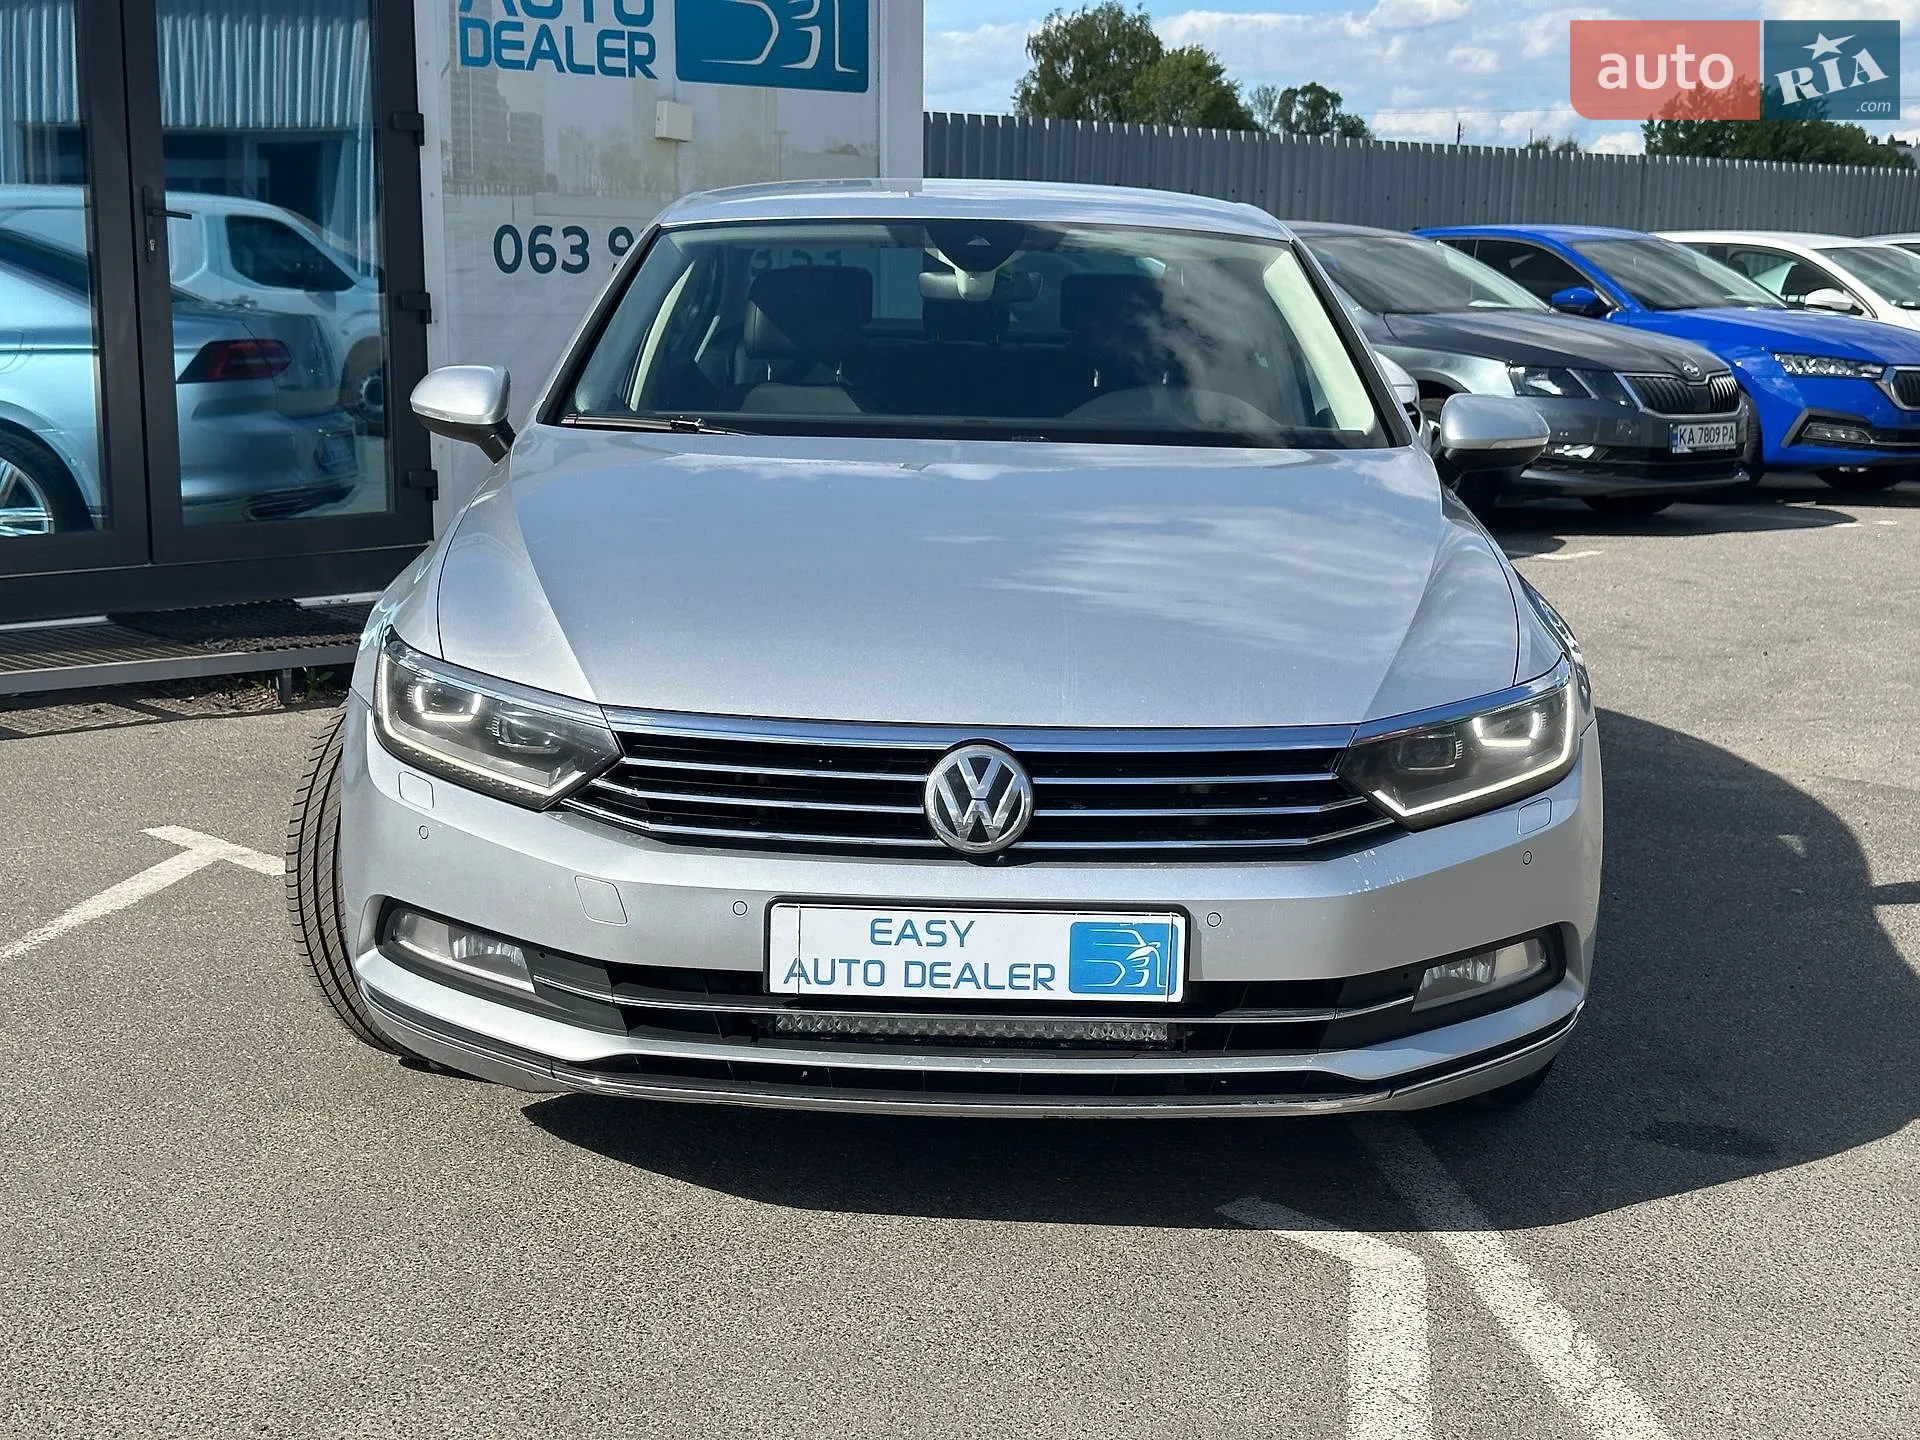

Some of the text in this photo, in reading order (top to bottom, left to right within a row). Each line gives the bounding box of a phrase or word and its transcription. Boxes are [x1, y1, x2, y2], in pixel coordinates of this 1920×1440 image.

[459, 16, 658, 80] DEALER
[493, 224, 590, 274] 063
[1679, 427, 1695, 445] KA
[1697, 426, 1720, 444] 7809
[1722, 425, 1735, 442] PA
[870, 918, 975, 948] EASY
[783, 957, 1055, 991] AUTO DEALER
